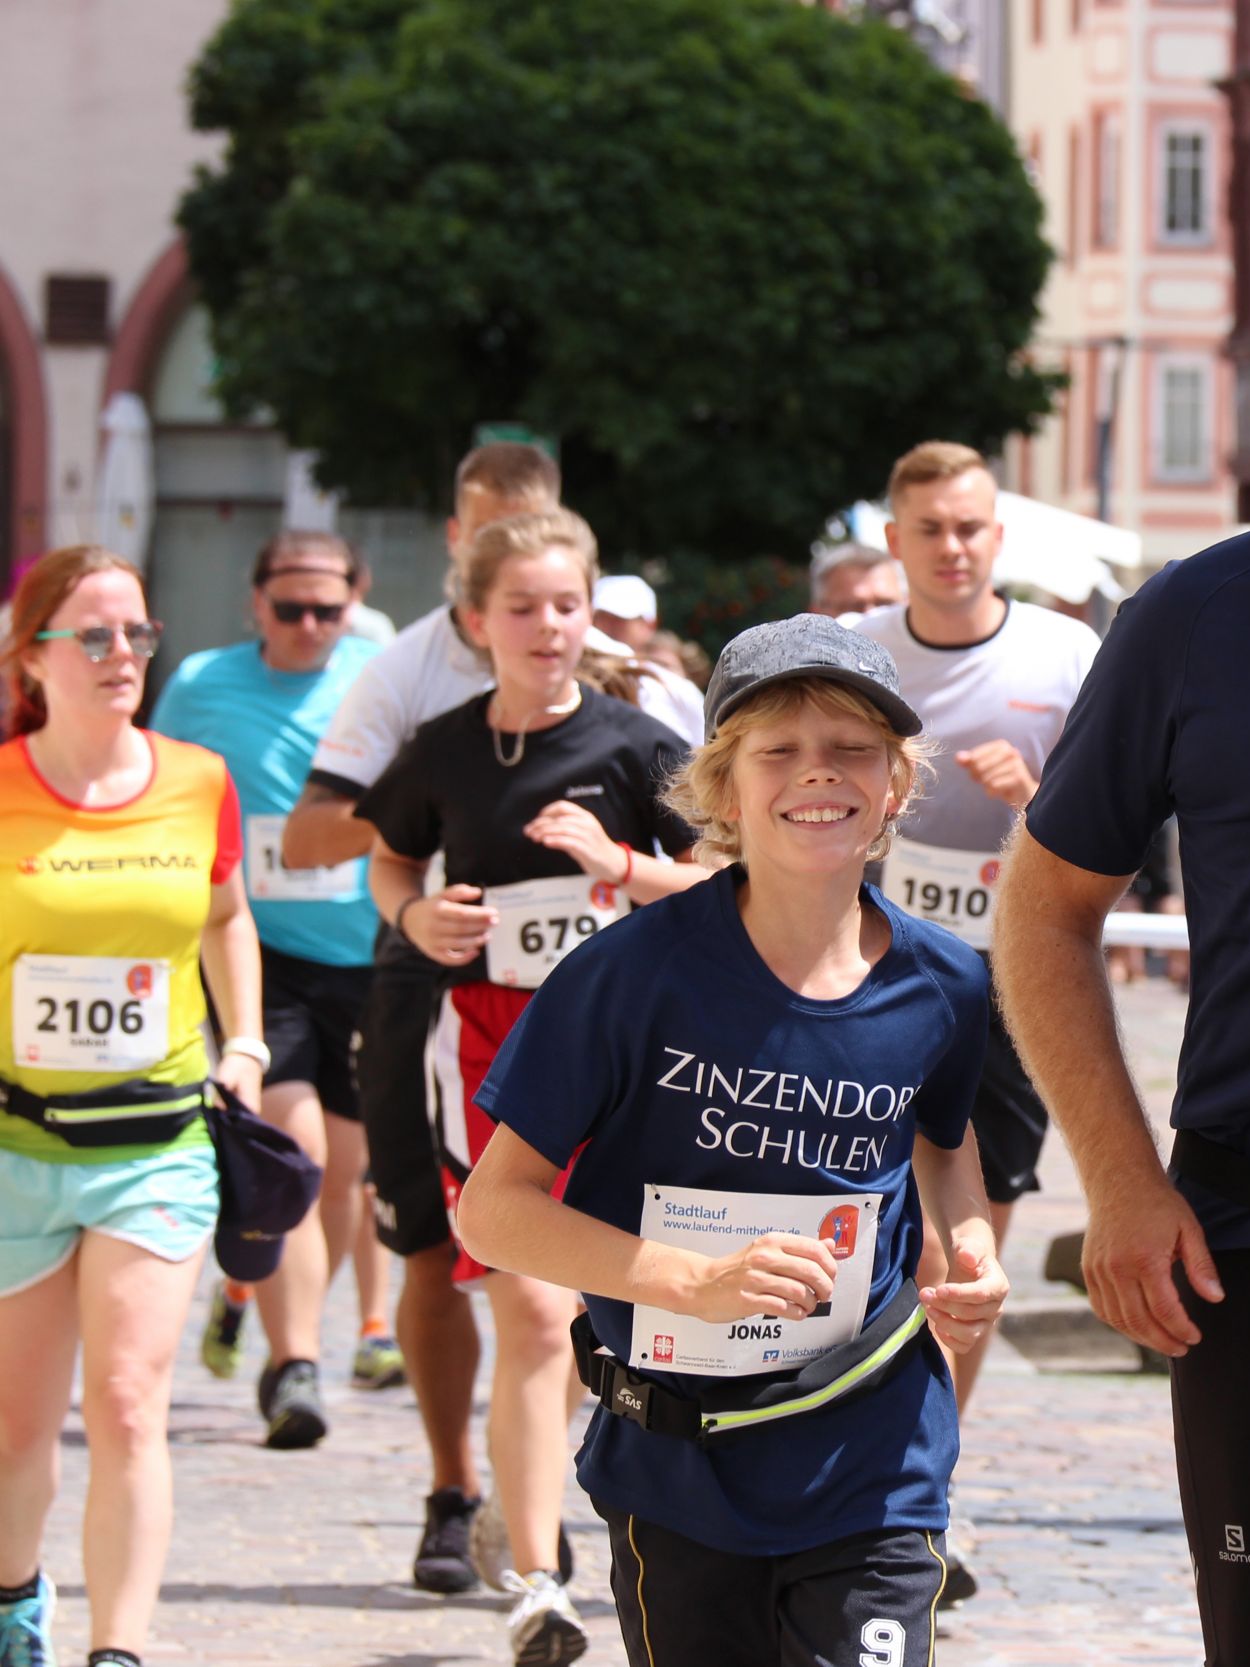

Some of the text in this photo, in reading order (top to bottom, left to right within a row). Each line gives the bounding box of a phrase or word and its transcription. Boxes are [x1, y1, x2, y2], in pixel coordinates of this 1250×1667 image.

[904, 878, 988, 917] 1910
[36, 998, 143, 1034] 2106
[657, 1047, 921, 1121] ZINZENDOR
[696, 1108, 887, 1171] SCHULEN
[665, 1202, 727, 1220] Stadtlauf
[728, 1325, 782, 1340] JONAS
[859, 1618, 906, 1667] 9
